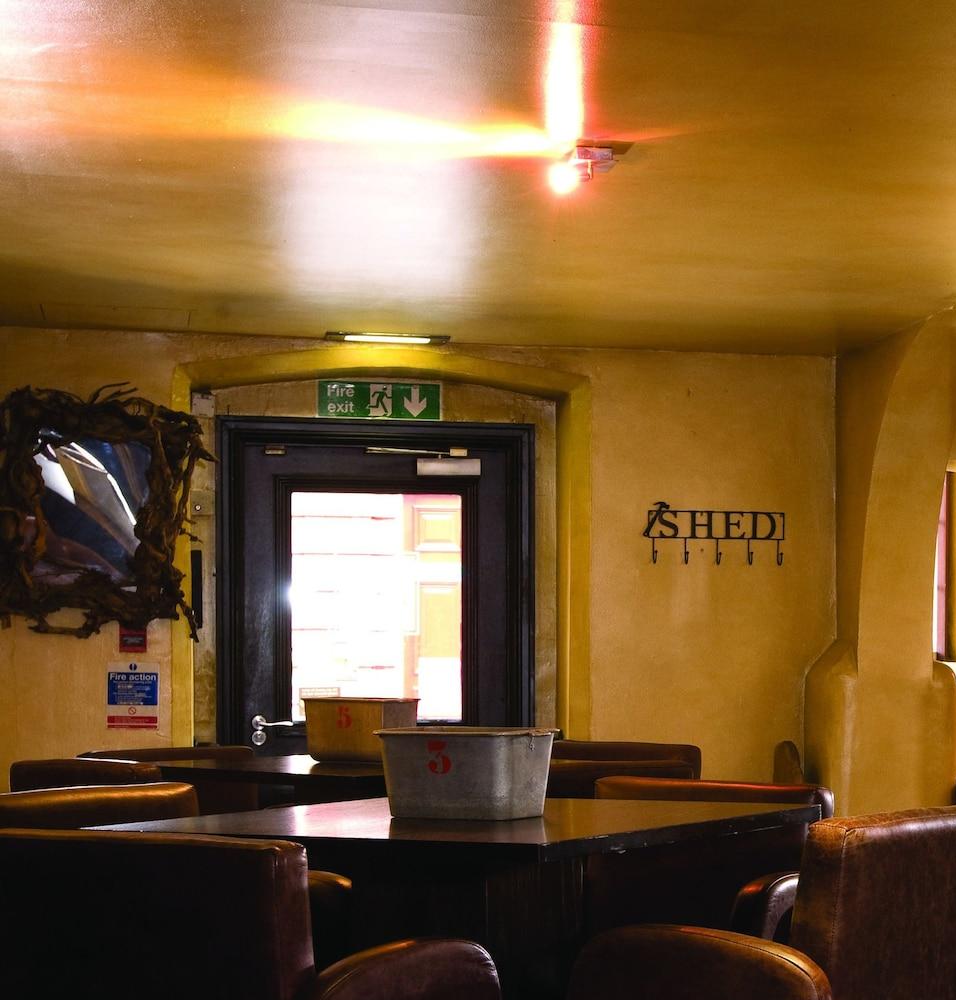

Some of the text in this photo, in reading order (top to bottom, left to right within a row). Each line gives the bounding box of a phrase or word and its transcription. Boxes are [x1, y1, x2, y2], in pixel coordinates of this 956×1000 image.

[327, 384, 355, 398] Fire
[327, 400, 355, 414] exit
[658, 510, 778, 540] SHED
[109, 672, 157, 681] Fire action
[427, 739, 452, 775] 3
